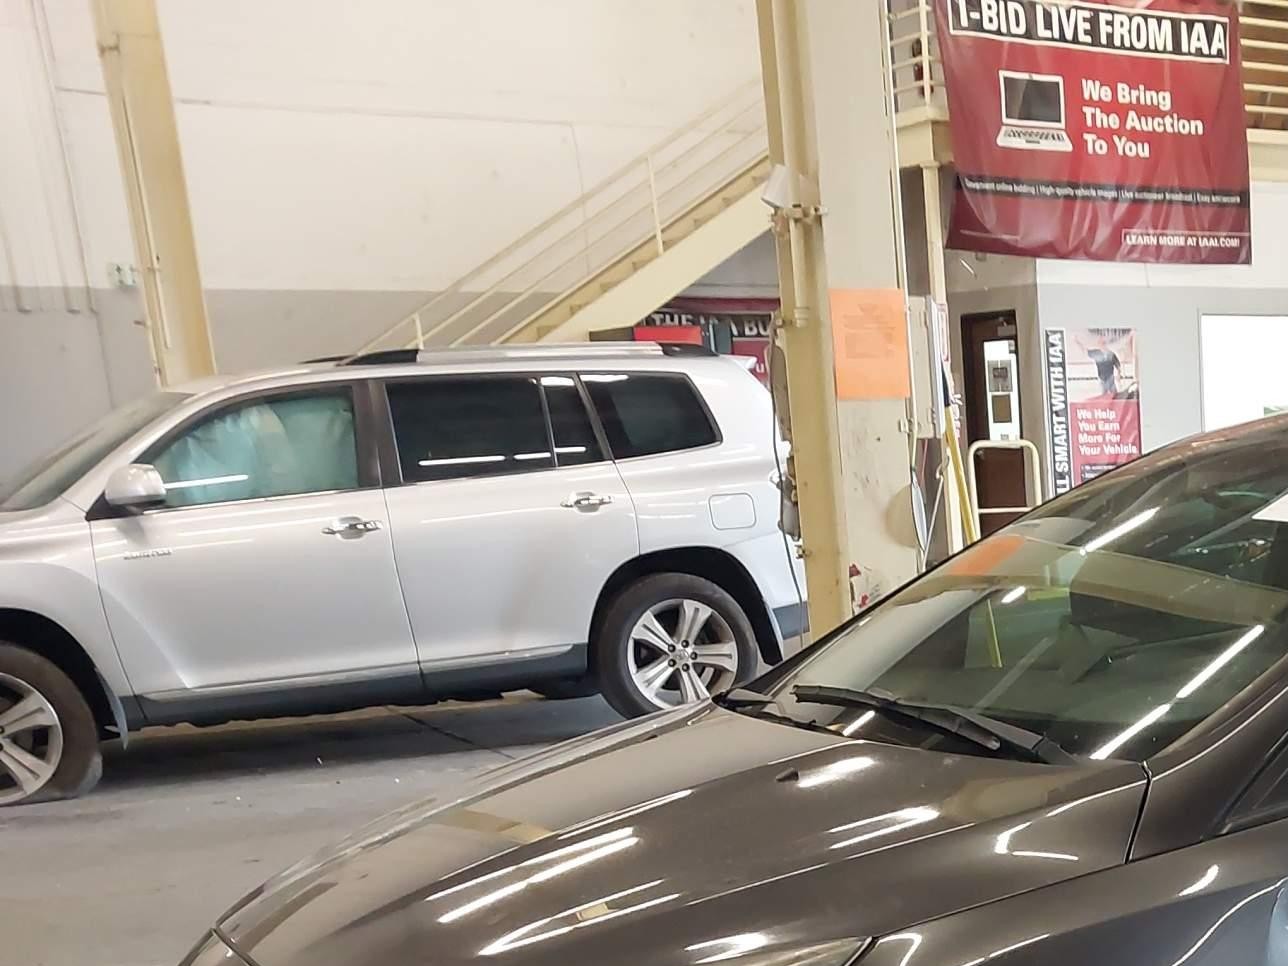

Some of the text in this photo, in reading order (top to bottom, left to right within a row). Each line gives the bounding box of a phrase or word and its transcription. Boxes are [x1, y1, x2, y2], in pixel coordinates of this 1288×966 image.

[1036, 4, 1093, 44] LIVE
[1099, 12, 1174, 51] FROM
[1180, 20, 1226, 55] IAA
[1081, 78, 1171, 111] We Bring
[1082, 106, 1204, 135] The Auction
[1082, 133, 1150, 158] To You
[1125, 233, 1157, 246] LEARN
[1158, 234, 1185, 247] MORE
[1186, 236, 1198, 247] AT
[744, 320, 770, 337] BU
[1048, 332, 1063, 364] IAA
[1048, 366, 1066, 412] WITH
[1077, 408, 1116, 421] We Help
[1078, 421, 1120, 432] You Earn
[1052, 413, 1069, 473] SMART
[1078, 432, 1121, 443] More For
[1079, 443, 1138, 455] Your Vehicle
